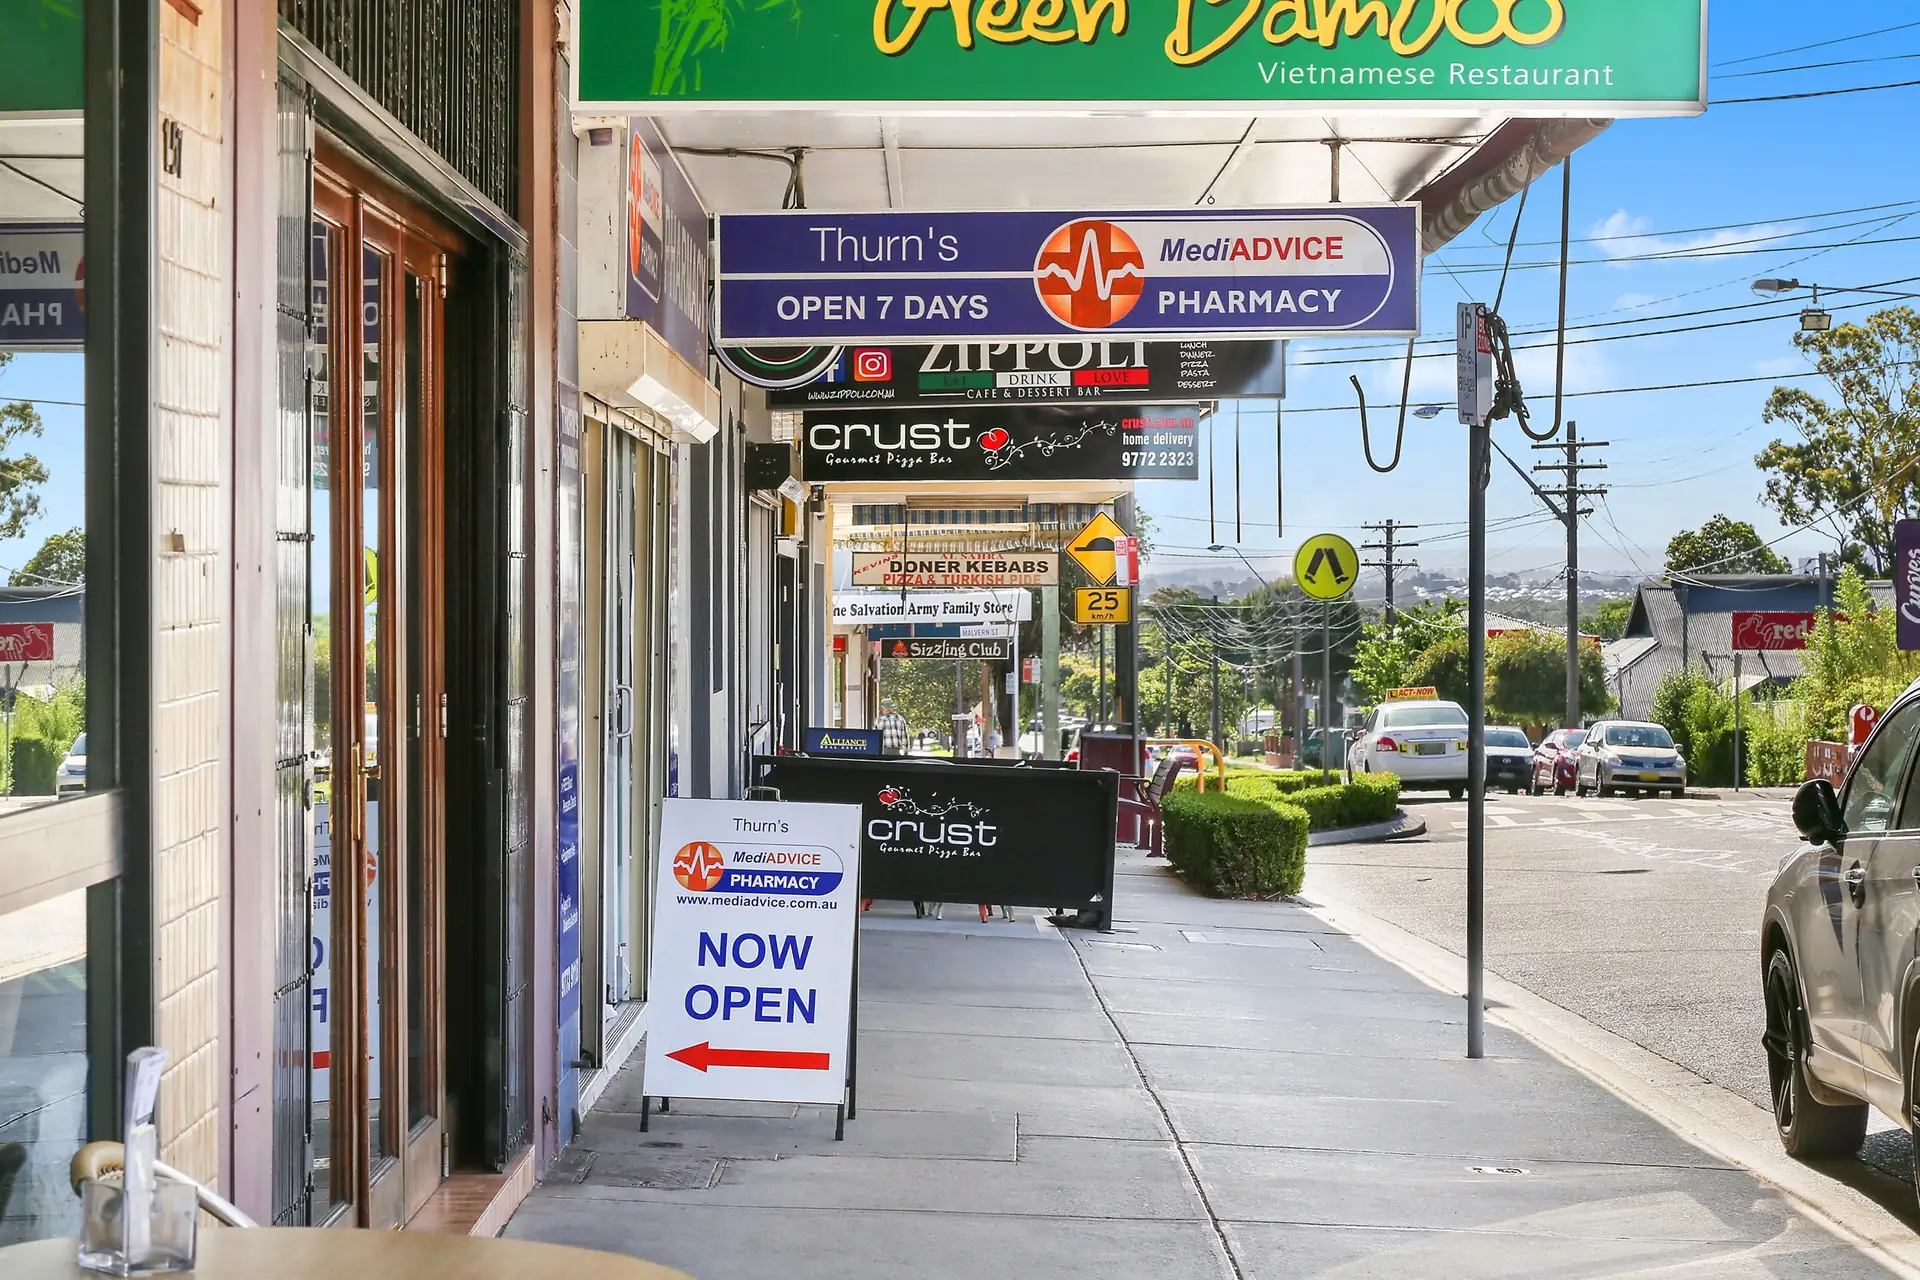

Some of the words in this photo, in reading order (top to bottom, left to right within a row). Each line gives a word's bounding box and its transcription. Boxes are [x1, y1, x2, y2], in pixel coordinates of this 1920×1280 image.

[1258, 60, 1435, 85] Vietnamese
[1449, 62, 1615, 86] Restaurant
[809, 226, 959, 262] Thurn's
[1159, 236, 1344, 262] MediADVICE
[776, 295, 866, 321] OPEN
[877, 296, 894, 320] 7
[904, 294, 989, 320] DAYS
[1158, 288, 1342, 314] PHARMACY
[919, 342, 1148, 372] ZIPPOLI
[1179, 351, 1216, 359] DINNER
[1180, 360, 1209, 368] PIZZA
[1009, 372, 1059, 386] DRINK
[1093, 371, 1130, 384] LOVE
[1180, 369, 1210, 377] PASTA
[1177, 380, 1217, 389] DESSERT
[966, 388, 998, 399] CAFE
[1003, 388, 1012, 398] &
[1018, 387, 1071, 398] DESSERT
[1077, 387, 1101, 397] BAR
[1121, 416, 1194, 429] crust.com.au
[809, 418, 971, 450] crust
[1122, 432, 1150, 446] home
[1153, 432, 1194, 448] delivery
[825, 452, 880, 465] Gourmet
[886, 452, 923, 468] Pizza
[930, 451, 953, 464] Bar
[1121, 451, 1156, 467] 9772
[1159, 451, 1195, 467] 2323
[853, 553, 900, 575] KEVINS
[890, 560, 960, 573] DONER
[966, 560, 1049, 573] KEBABS
[883, 573, 923, 585] PIZZA
[927, 574, 937, 585] &
[942, 574, 1004, 585] TURKISH
[1009, 573, 1041, 585] PIDE
[850, 602, 904, 617] Salvation
[907, 602, 939, 617] Army
[942, 601, 980, 617] Family
[983, 601, 1013, 614] Store
[1088, 591, 1119, 611] 25
[1091, 612, 1115, 620] km/h
[962, 628, 990, 637] MALVERN
[991, 628, 999, 636] ST
[1773, 619, 1808, 640] red
[910, 639, 967, 658] Sizzling
[968, 641, 1002, 657] Club
[1398, 688, 1435, 697] ACT-NOW
[820, 733, 867, 747] ALLIANCE
[732, 818, 789, 833] Thurn's
[868, 818, 997, 847] crust
[732, 851, 821, 866] MediADVICE
[879, 842, 924, 854] Gourmet
[928, 846, 958, 859] Pizza
[962, 848, 982, 858] Bar
[730, 874, 820, 890] PHARMACY
[676, 894, 838, 910] www.mediadvice.com.au
[697, 931, 814, 971] NOW
[684, 984, 817, 1024] OPEN
